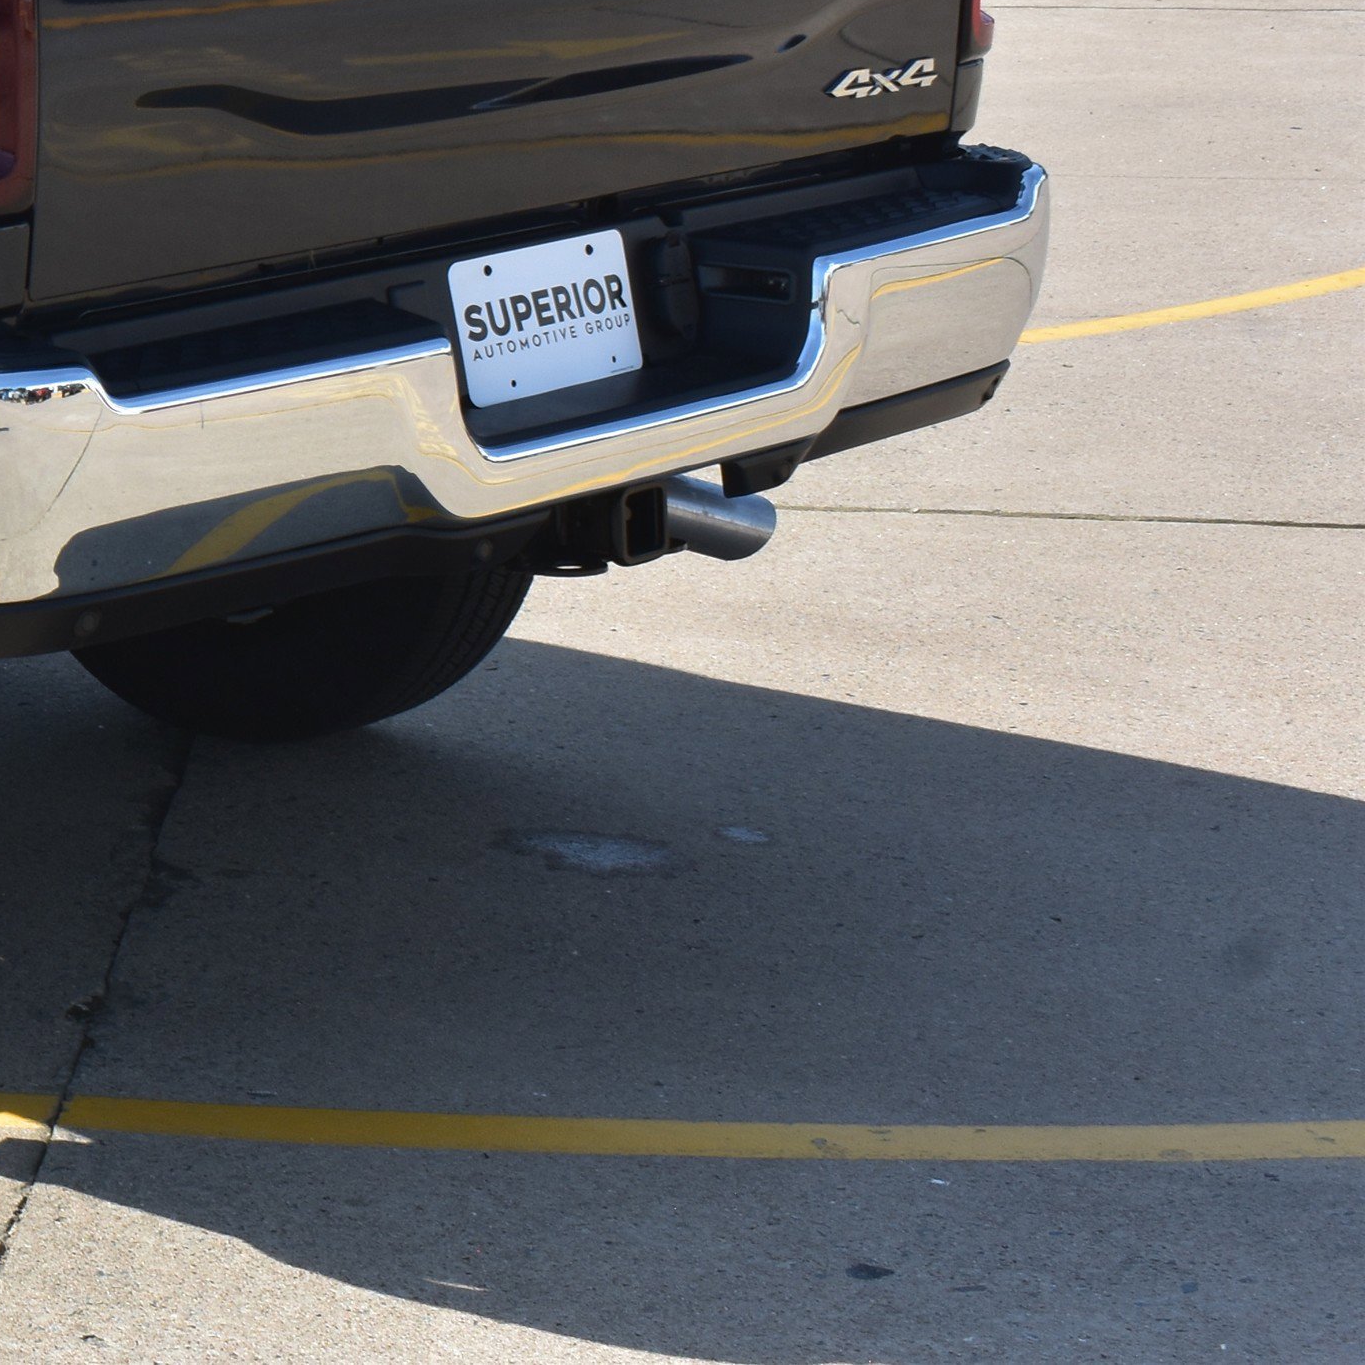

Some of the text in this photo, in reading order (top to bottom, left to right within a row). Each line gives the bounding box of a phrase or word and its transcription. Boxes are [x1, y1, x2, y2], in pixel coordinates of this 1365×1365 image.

[826, 57, 938, 99] 4x4
[464, 274, 627, 342] SUPERIOR
[473, 313, 631, 362] AUTOMOTIVE GROUP
